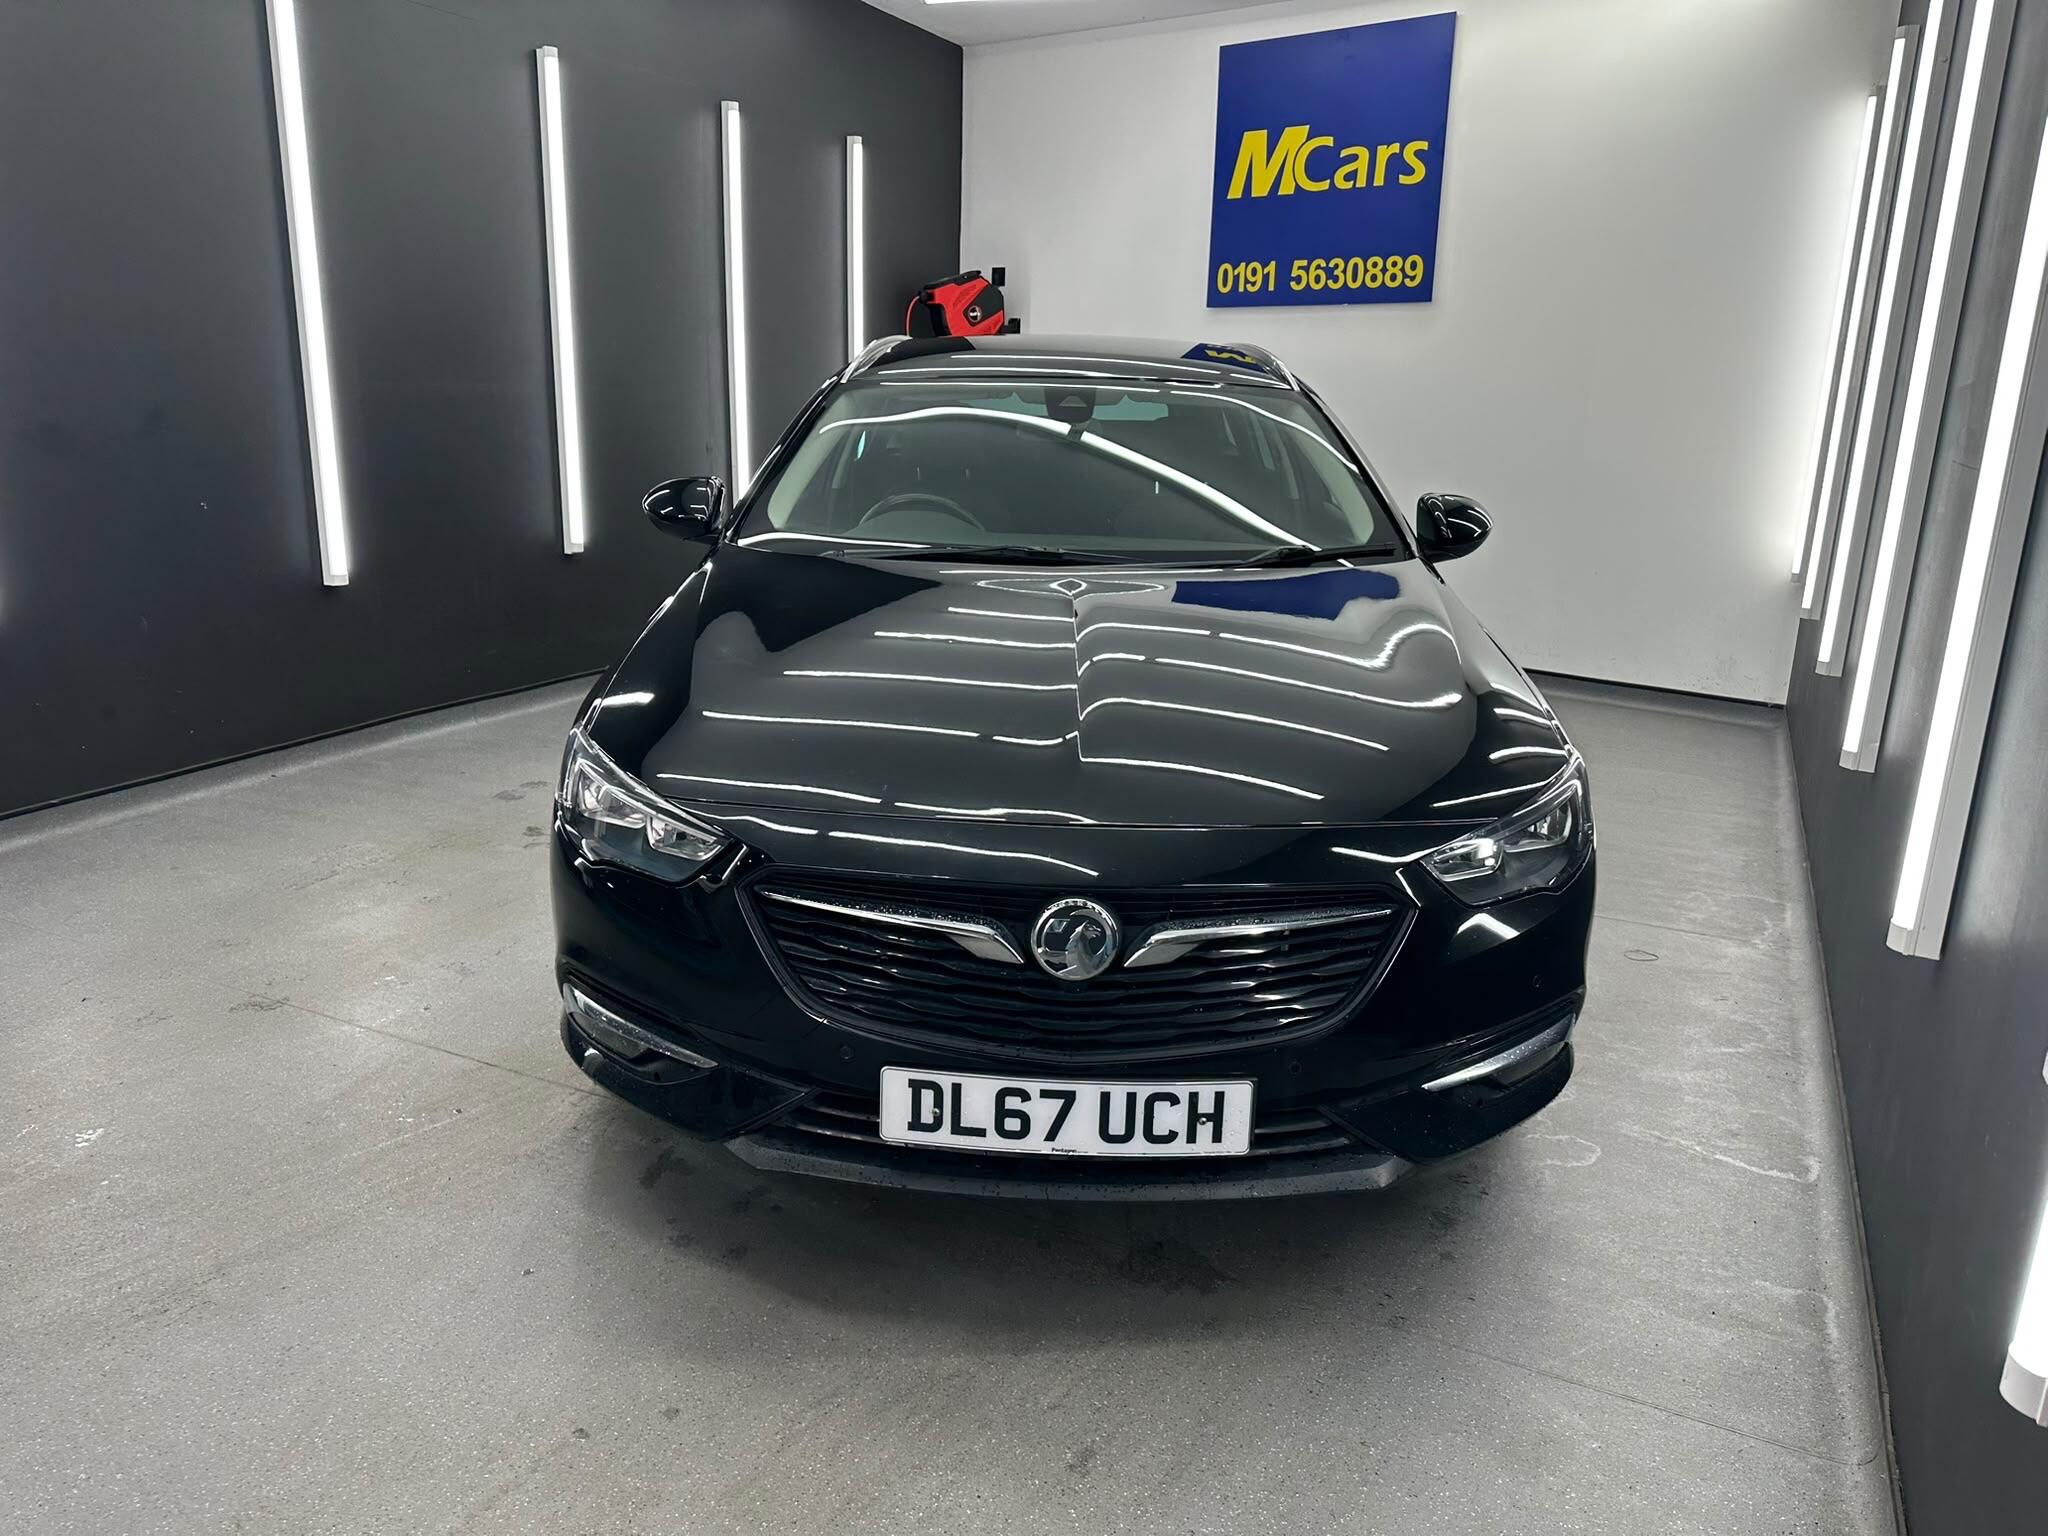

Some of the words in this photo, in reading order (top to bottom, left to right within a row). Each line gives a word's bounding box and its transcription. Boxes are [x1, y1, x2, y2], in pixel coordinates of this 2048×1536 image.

[1226, 124, 1429, 200] MCars
[1217, 261, 1276, 293] 0191
[1290, 254, 1424, 291] 5630889
[907, 1078, 1077, 1142] DL67
[1099, 1090, 1226, 1144] UCH
